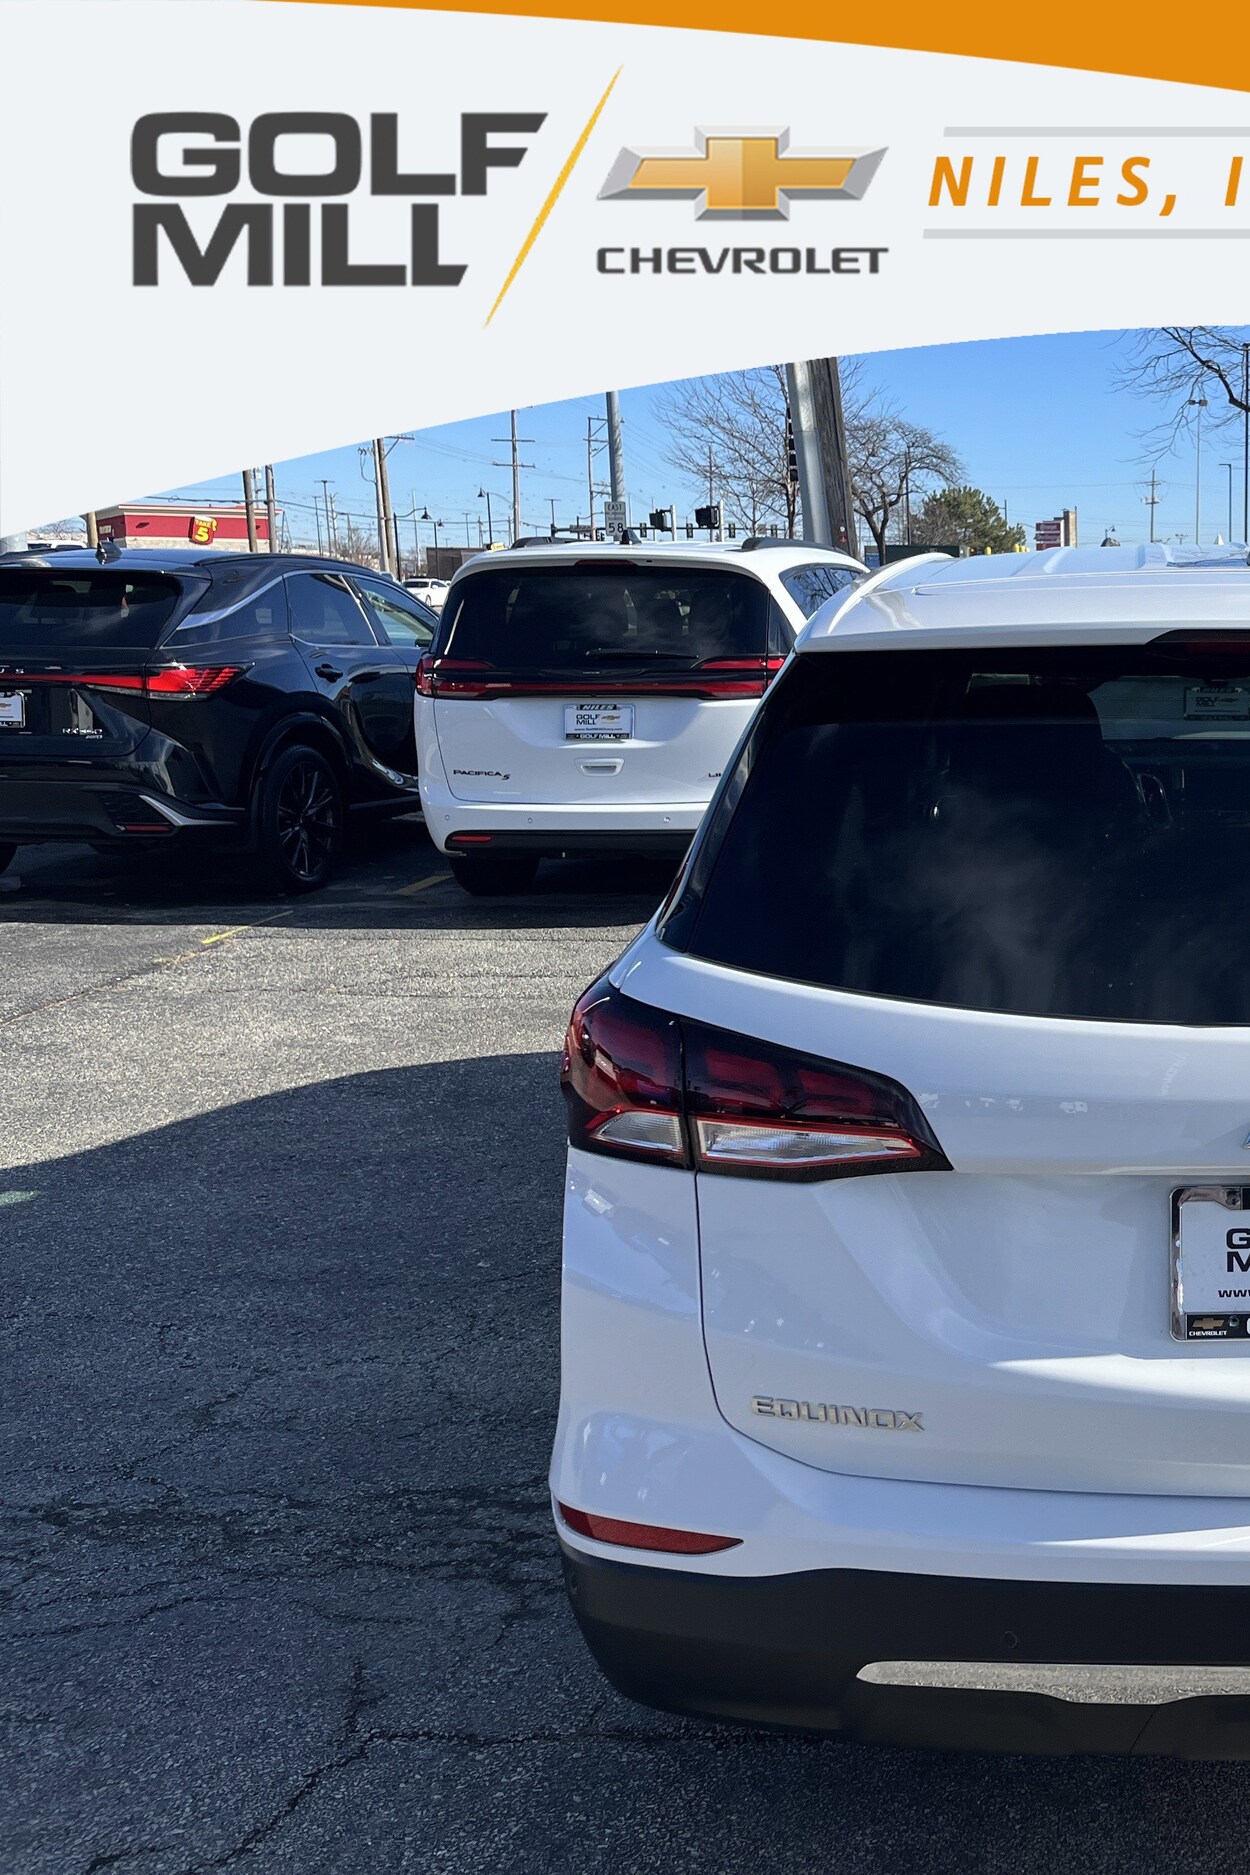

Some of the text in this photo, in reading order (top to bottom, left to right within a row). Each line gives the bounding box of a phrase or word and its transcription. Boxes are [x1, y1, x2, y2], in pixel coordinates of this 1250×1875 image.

[607, 503, 623, 511] EAST
[608, 522, 624, 533] 58
[194, 526, 209, 542] 5
[453, 769, 503, 777] PACIFICA
[1188, 1329, 1228, 1337] CHEVROLET
[751, 1394, 925, 1433] EQUINOX
